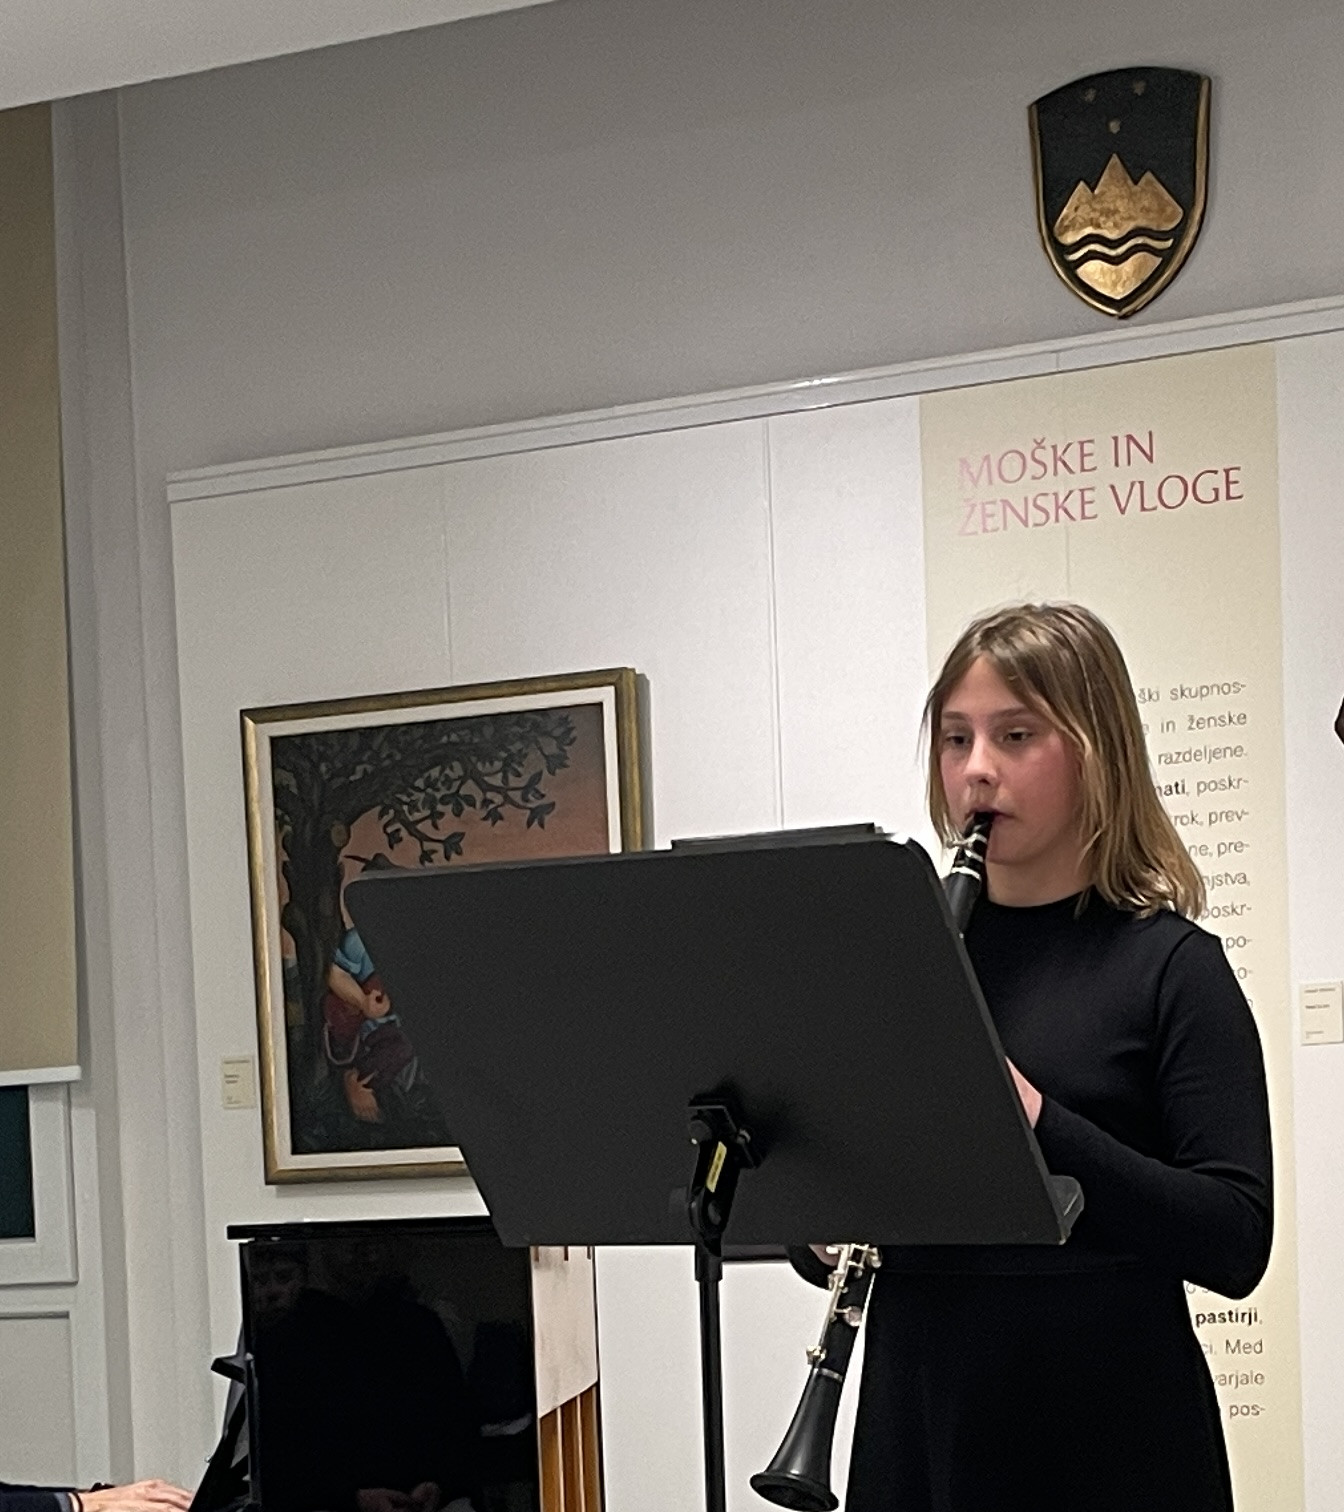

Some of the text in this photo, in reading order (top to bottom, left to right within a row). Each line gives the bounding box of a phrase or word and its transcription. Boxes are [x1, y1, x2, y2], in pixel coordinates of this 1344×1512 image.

[958, 430, 1156, 490] MOŠKE IN
[957, 466, 1245, 537] ŽENSKE VLOGE
[1170, 681, 1247, 700] skupnos-
[1160, 719, 1176, 734] in
[1187, 711, 1247, 731] ženske
[1196, 775, 1249, 797] poskr-
[1217, 840, 1250, 858] pre-
[1225, 1338, 1263, 1355] Med
